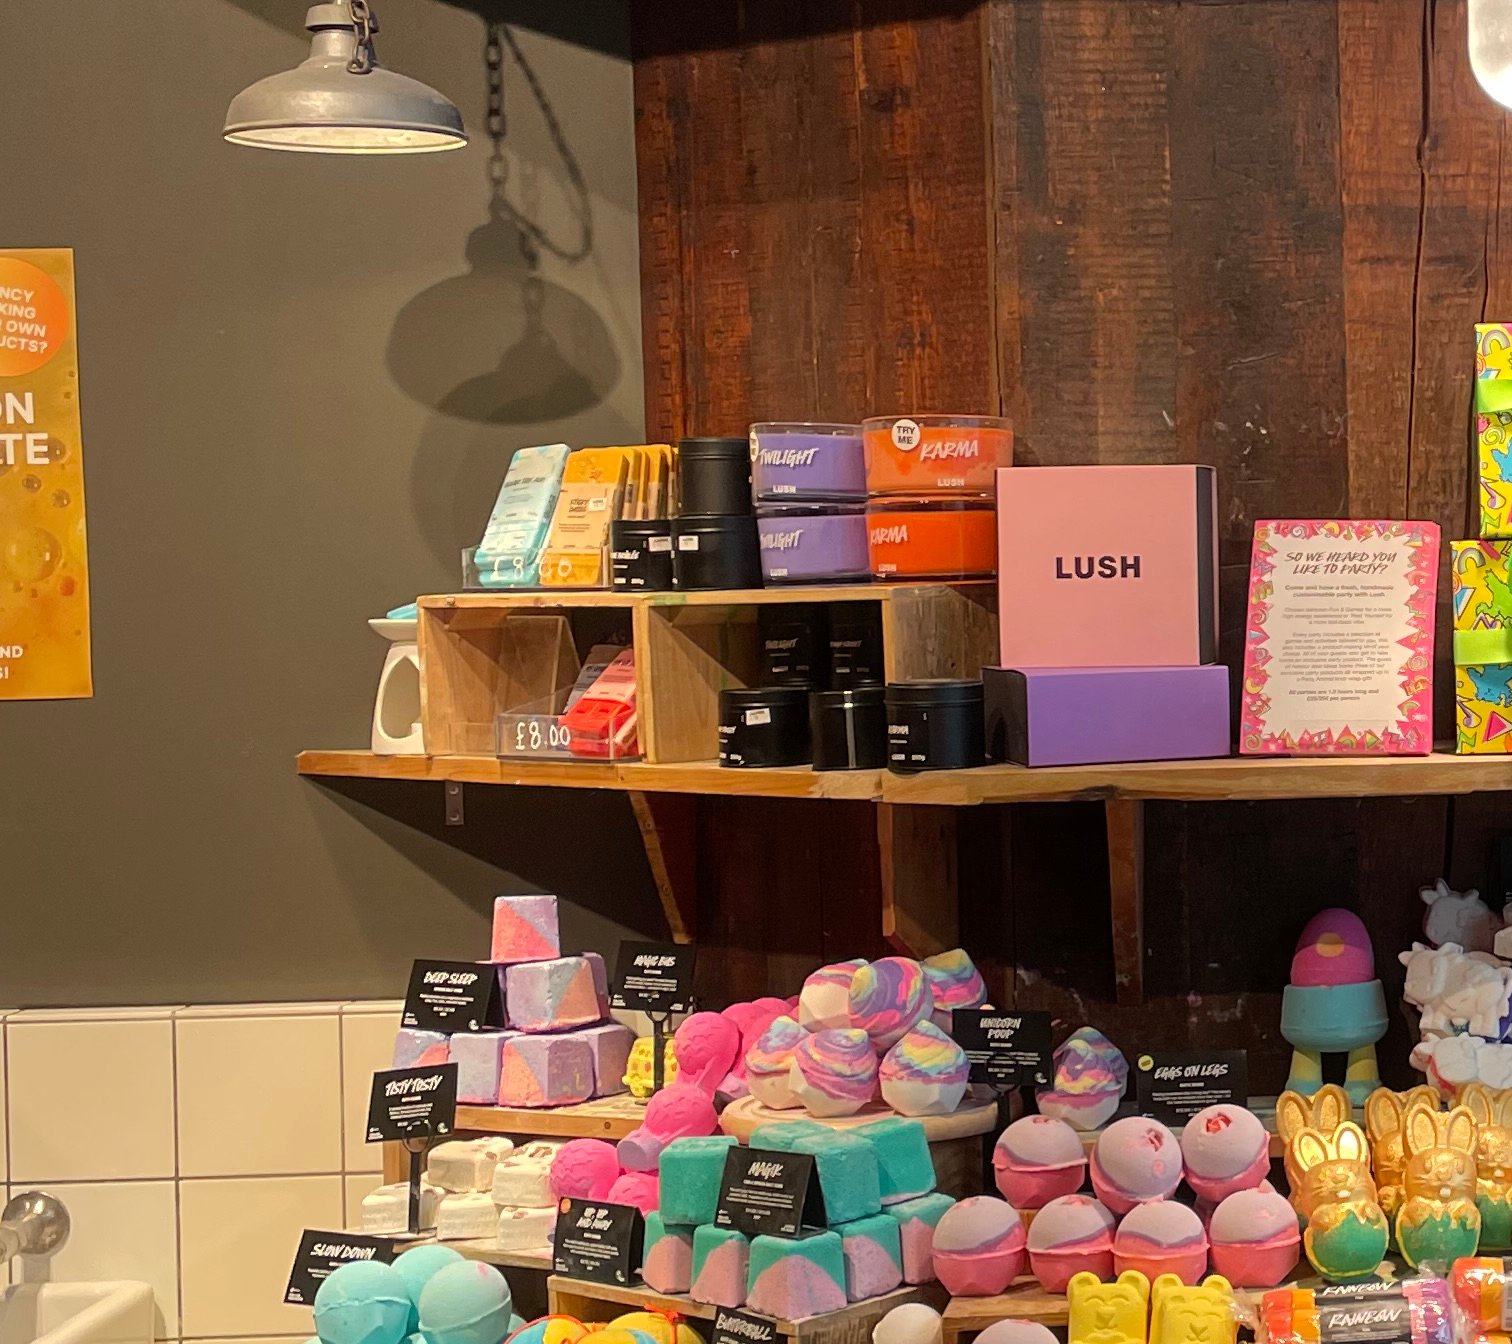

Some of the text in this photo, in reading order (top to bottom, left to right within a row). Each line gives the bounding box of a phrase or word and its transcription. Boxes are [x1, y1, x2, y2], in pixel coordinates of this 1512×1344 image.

[759, 447, 820, 467] TWILIGHT
[920, 440, 979, 461] KARMA
[760, 529, 804, 549] WILIGHT
[1056, 555, 1141, 579] LUSH
[1285, 552, 1398, 563] SO WE HEARD YOU
[1293, 563, 1389, 575] LIKE TO PARTY?
[515, 722, 571, 751] £8.00
[1154, 1063, 1229, 1080] EGGS ON LEGS
[310, 1242, 376, 1261] SLOW DOWN
[1328, 1308, 1402, 1329] RAINBOW
